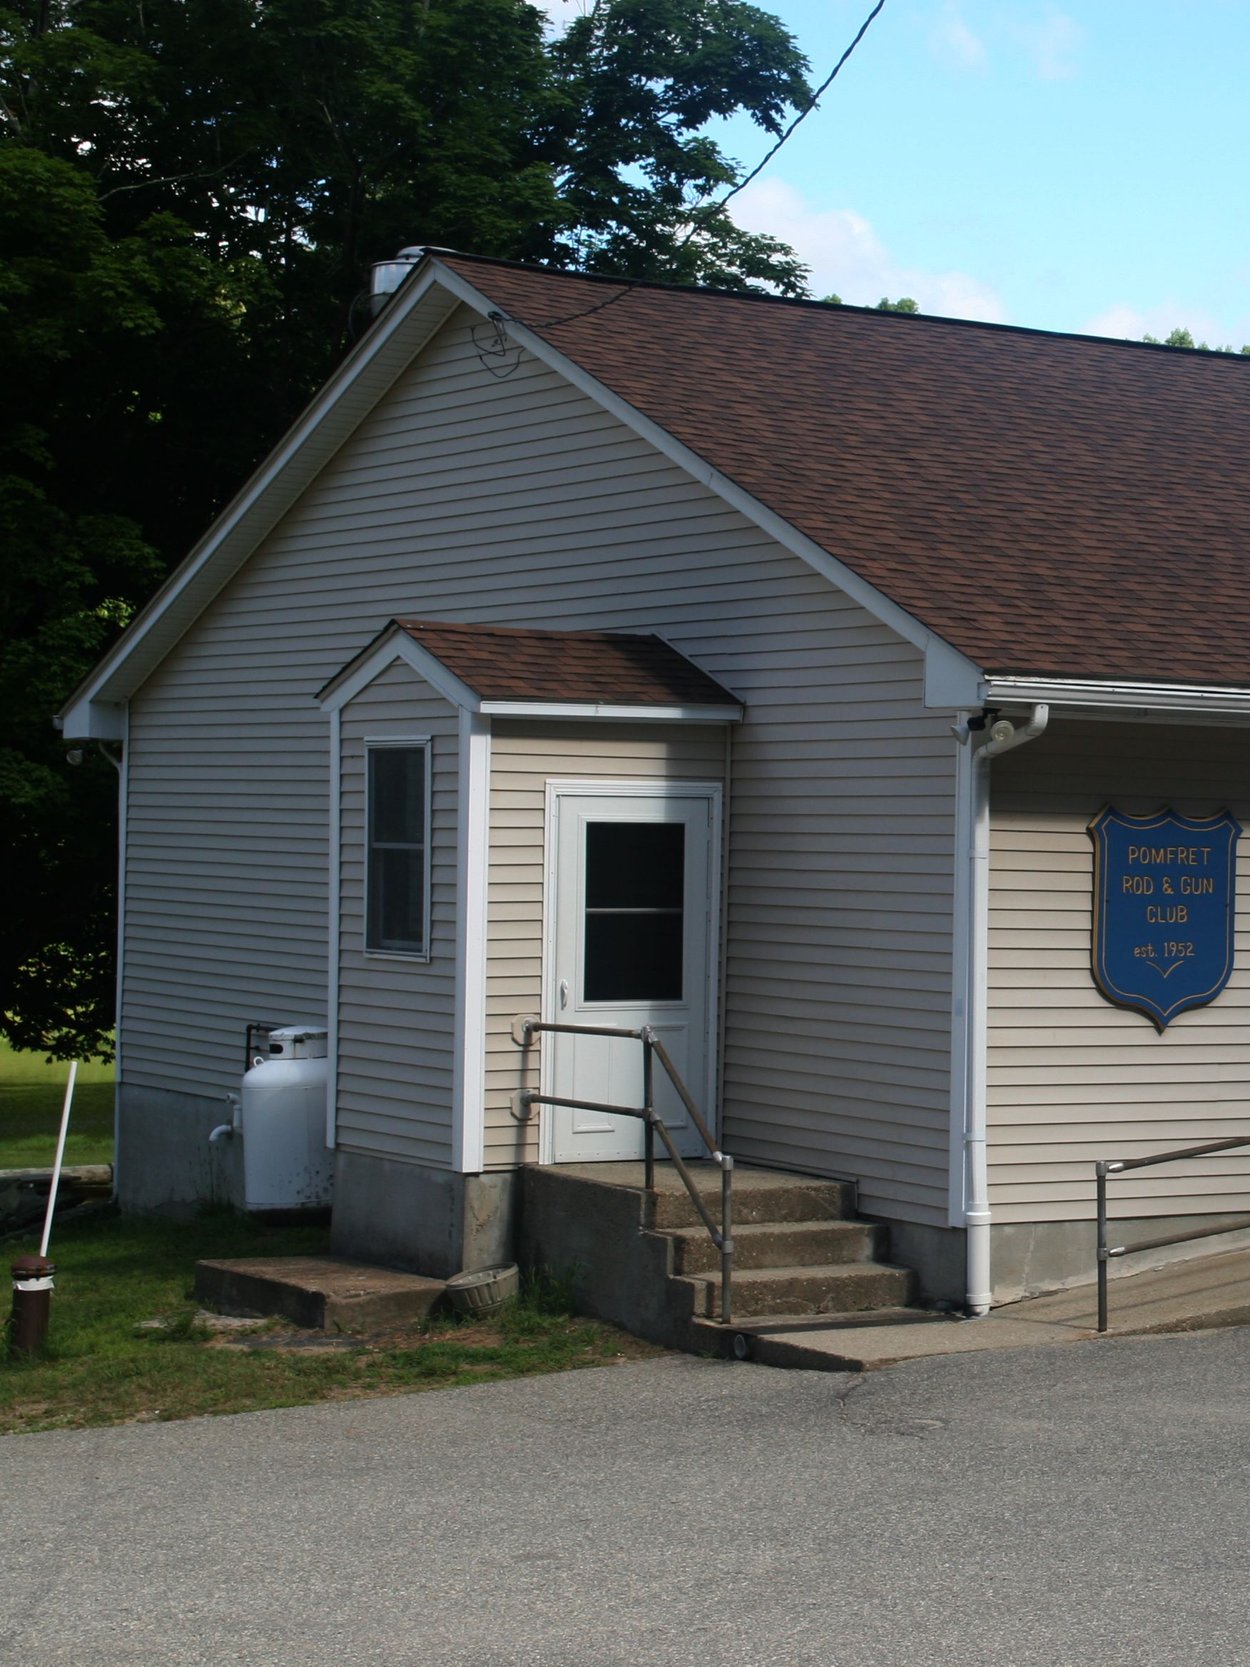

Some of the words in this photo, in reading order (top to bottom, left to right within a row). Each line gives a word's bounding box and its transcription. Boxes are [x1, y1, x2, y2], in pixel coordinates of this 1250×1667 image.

[1127, 845, 1212, 866] POMFRET
[1122, 876, 1154, 895] ROD
[1162, 876, 1175, 895] &
[1180, 876, 1214, 895] GUN
[1146, 905, 1188, 923] CLUB
[1133, 943, 1158, 958] est.
[1163, 941, 1195, 957] 1952
